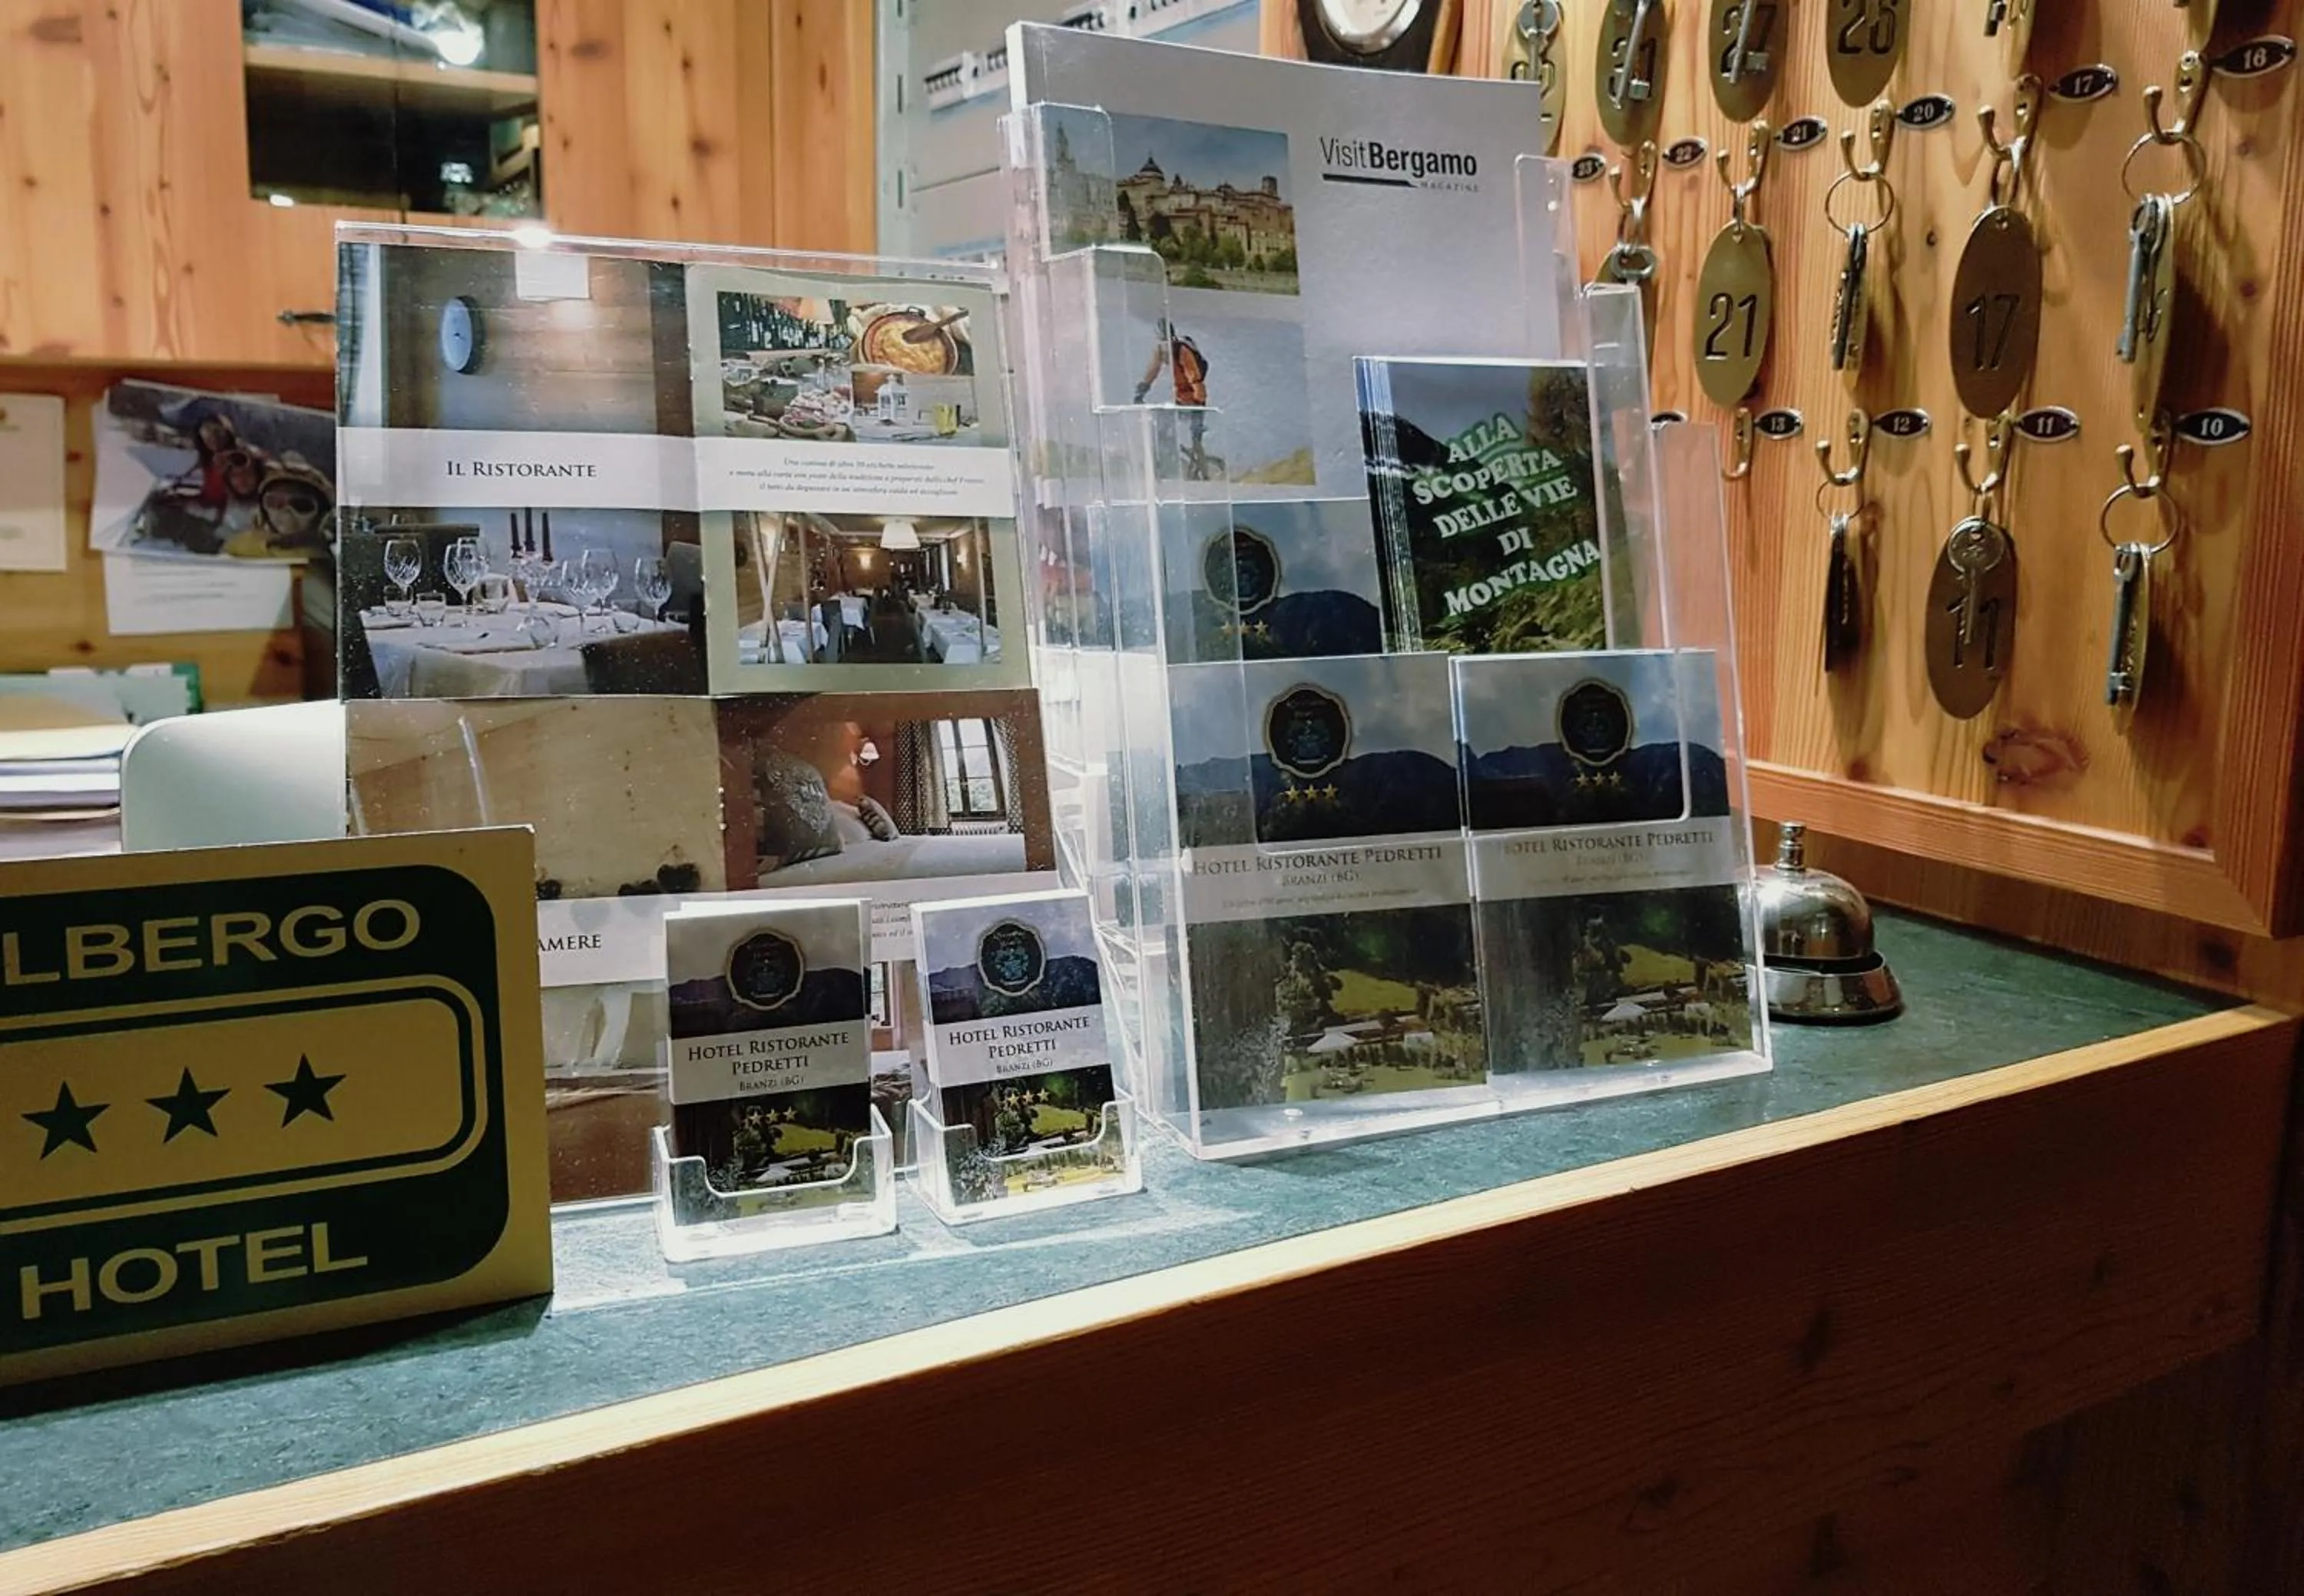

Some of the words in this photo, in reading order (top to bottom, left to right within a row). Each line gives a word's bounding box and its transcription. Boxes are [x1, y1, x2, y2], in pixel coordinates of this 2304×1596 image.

[2074, 75, 2095, 95] 17
[1913, 102, 1935, 123] 20
[1320, 135, 1478, 178] VisitBergamo
[1706, 293, 1757, 360] 21
[1966, 295, 2020, 370] 17
[1770, 416, 1786, 432] 13
[1892, 416, 1911, 432] 12
[2037, 416, 2055, 435] 11
[2200, 417, 2224, 436] 10
[1448, 415, 1520, 464] ALLA
[473, 461, 598, 478] RISTORANTE
[1412, 448, 1562, 505] SCOPERTA
[1433, 492, 1522, 539] DELLE
[1522, 475, 1579, 510] VIE
[1497, 527, 1535, 556] DI
[1443, 539, 1601, 617] MONTAGNA
[1552, 835, 1641, 852] RISTORANTE
[1193, 859, 1250, 876] HOTEL
[1256, 850, 1361, 872] RISTORANTE
[1365, 846, 1442, 864] PEDRETTI
[3, 899, 422, 985] LBERGO
[687, 1043, 744, 1061] HOTEL
[750, 1031, 849, 1055] RISTORANTE
[948, 1029, 998, 1047] HOTEL
[1001, 1016, 1091, 1038] RISTORANTE
[988, 1039, 1058, 1059] PEDRETTI
[732, 1055, 810, 1076] PEDRETTI
[739, 1080, 776, 1092] BRANZI
[20, 1221, 369, 1320] HOTEL
